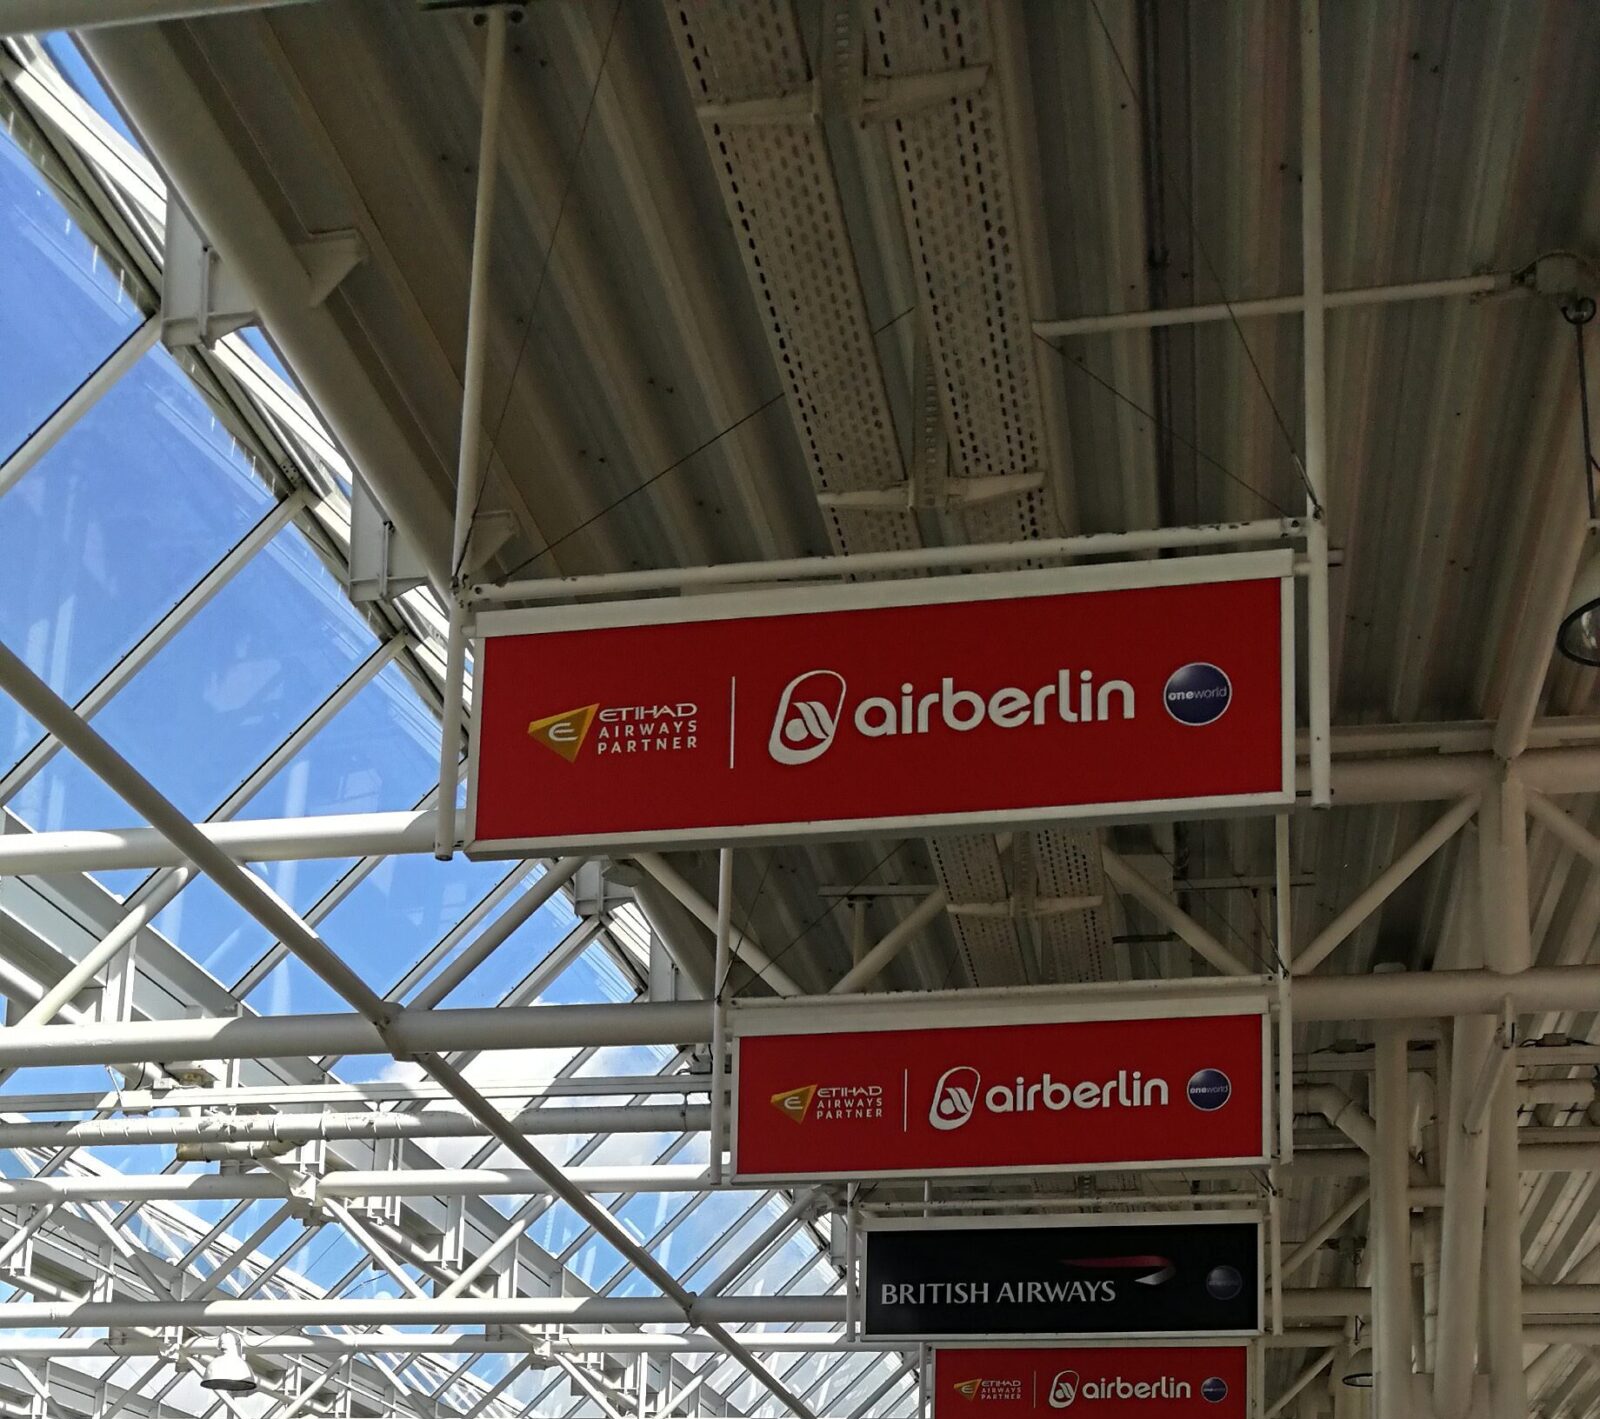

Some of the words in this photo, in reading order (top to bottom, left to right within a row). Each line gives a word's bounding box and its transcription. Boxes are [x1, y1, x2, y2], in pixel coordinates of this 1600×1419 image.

[854, 669, 1135, 737] airberlin
[1167, 686, 1228, 701] oneworld
[599, 703, 698, 722] ETIHAD
[598, 720, 698, 739] AIRWAYS
[597, 736, 698, 755] PARTNER
[817, 1086, 882, 1098] ETIHAD
[985, 1070, 1169, 1113] airberlin
[817, 1097, 882, 1109] AIRWAYS
[816, 1108, 882, 1119] PARTNER
[881, 1282, 989, 1304] BRITISH
[996, 1280, 1116, 1303] AIRWAYS
[981, 1379, 1021, 1387] ETIHAD
[1082, 1376, 1191, 1399] airberlin
